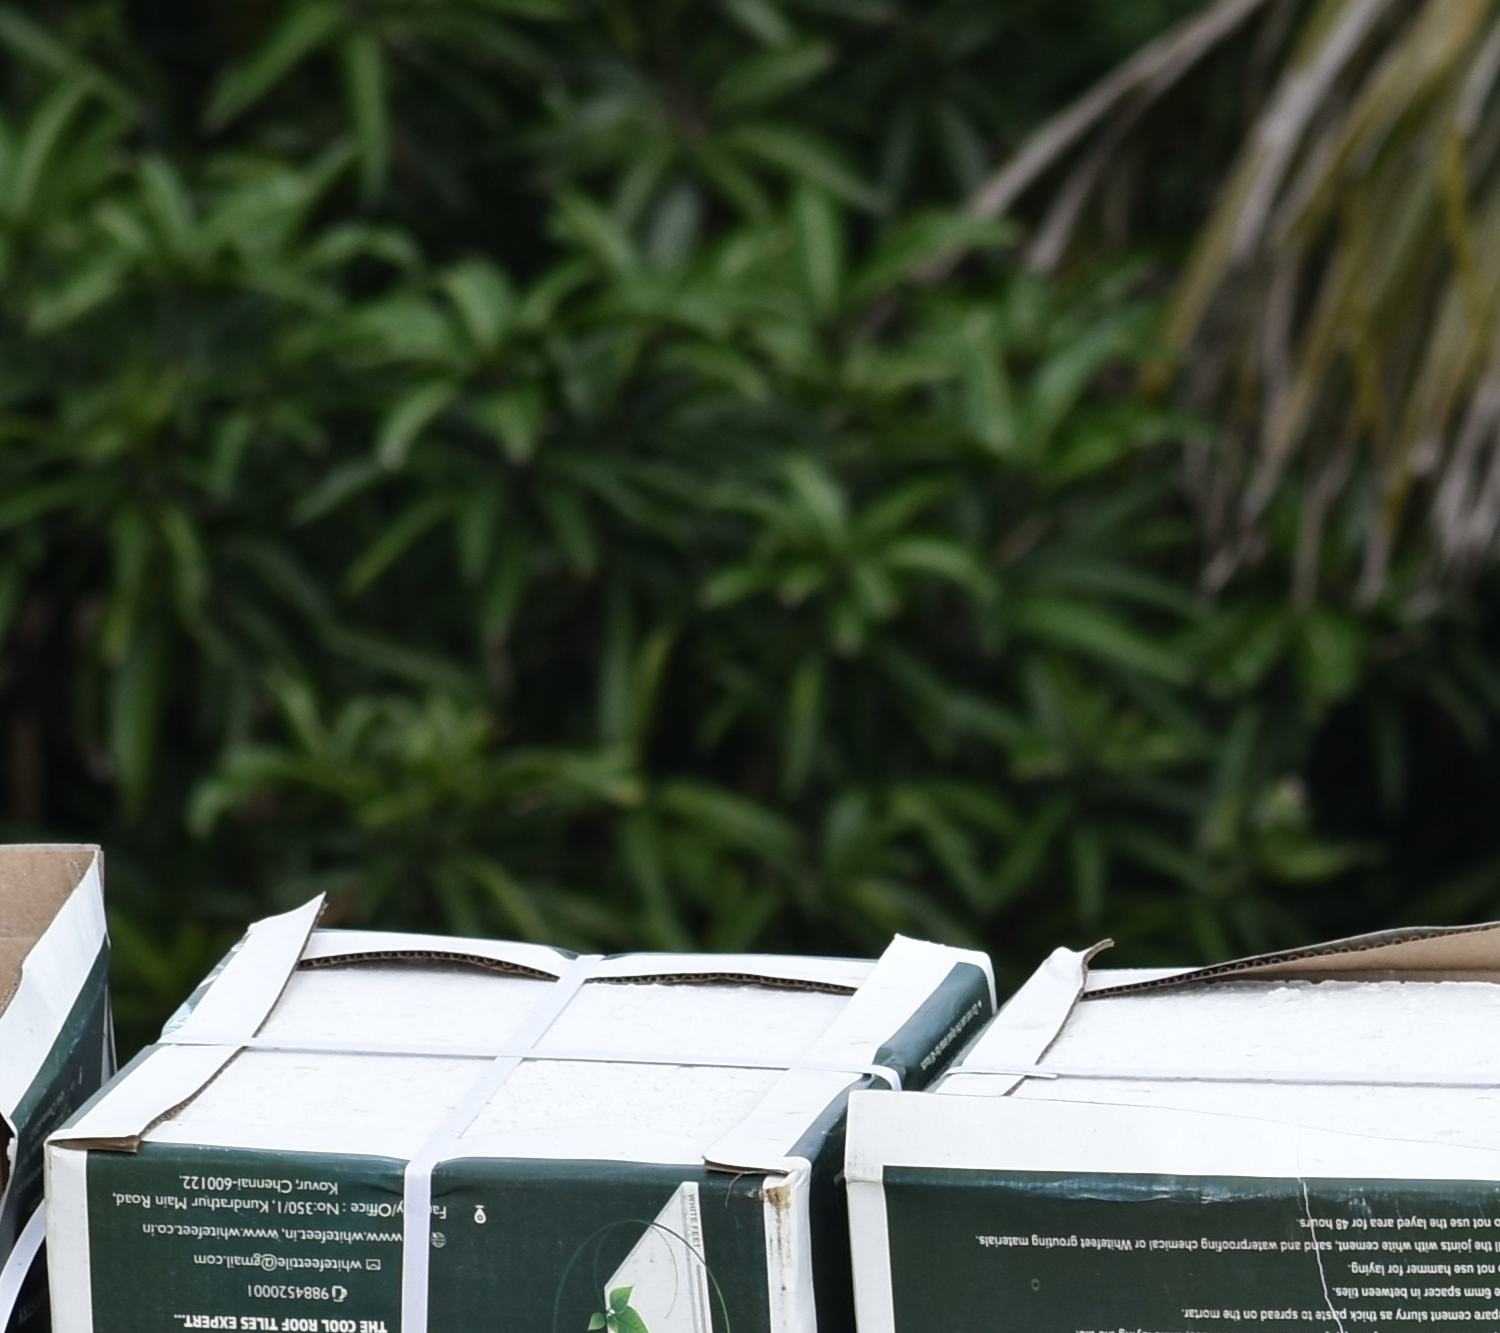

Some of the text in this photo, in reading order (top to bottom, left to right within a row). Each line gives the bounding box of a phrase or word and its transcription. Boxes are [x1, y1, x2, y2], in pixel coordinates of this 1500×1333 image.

[294, 1178, 339, 1196] Kovur,
[112, 1192, 152, 1209] Road,
[154, 1195, 188, 1211] Main
[190, 1196, 270, 1214] Kundrathur
[193, 1252, 363, 1273] whitefeettile@gmail.com
[247, 1284, 330, 1301] 9884520001
[239, 1315, 280, 1332] TILES
[280, 1317, 319, 1333] ROOF
[320, 1318, 358, 1333] COOL
